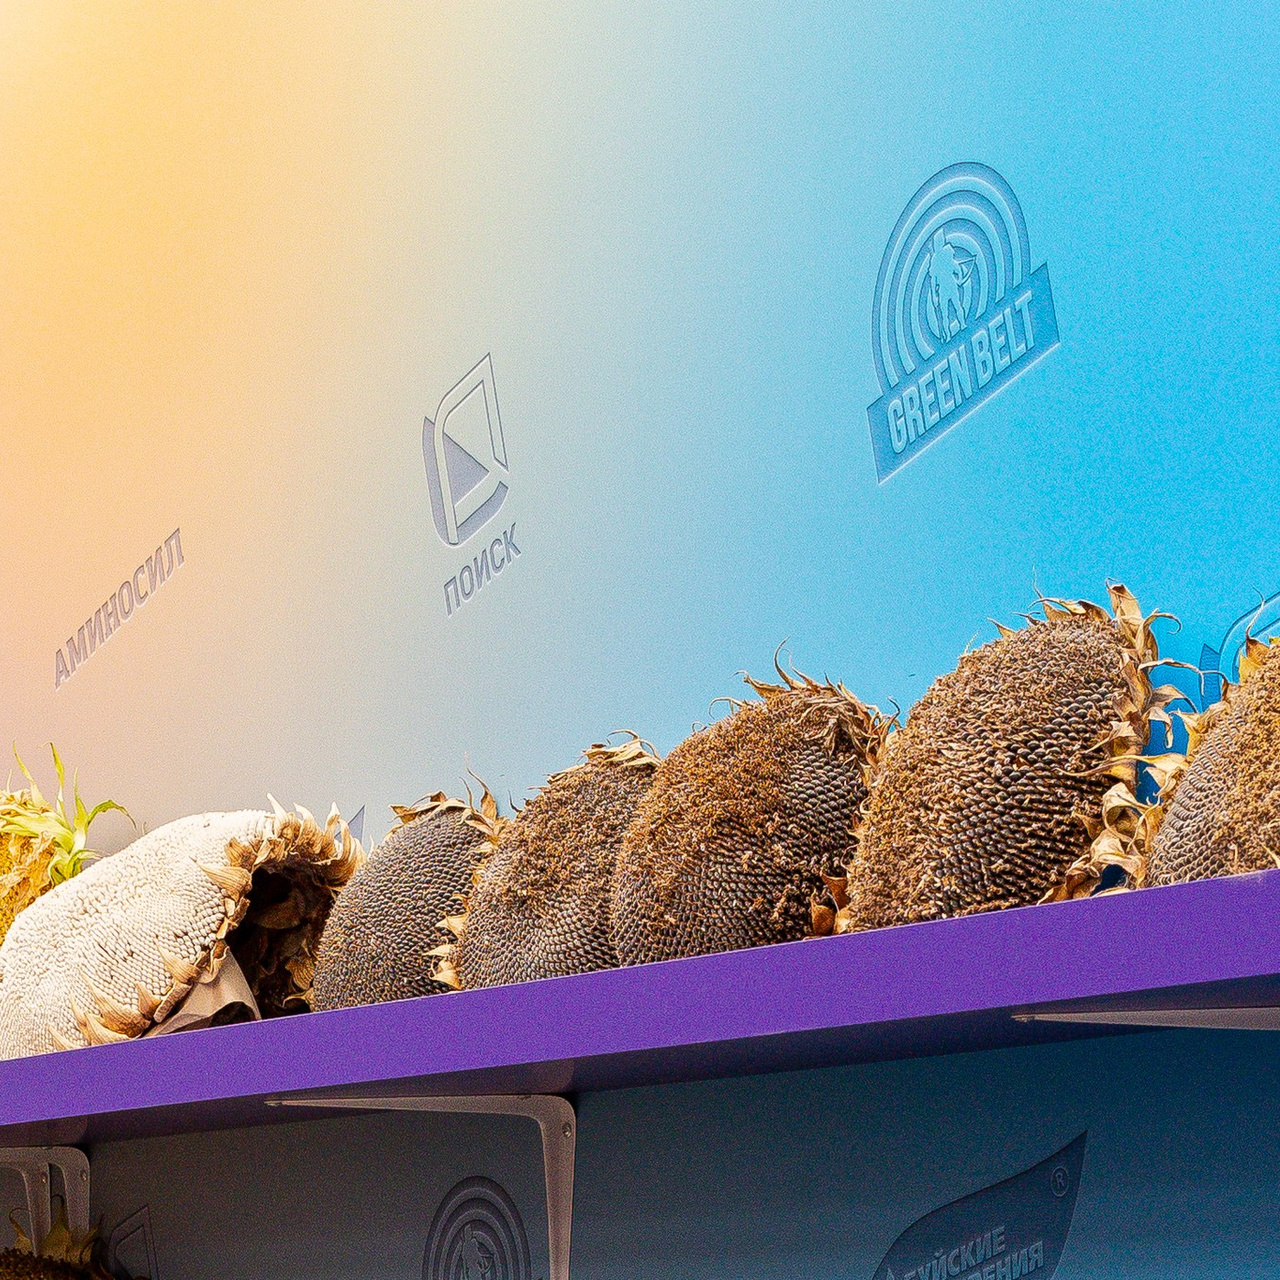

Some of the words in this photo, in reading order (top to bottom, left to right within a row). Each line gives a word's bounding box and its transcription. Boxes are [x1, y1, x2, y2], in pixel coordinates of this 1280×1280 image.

[887, 344, 973, 454] GREEN
[971, 290, 1036, 389] BELT
[53, 528, 186, 690] АМИНОСИЛ
[442, 522, 521, 617] ПОИСК
